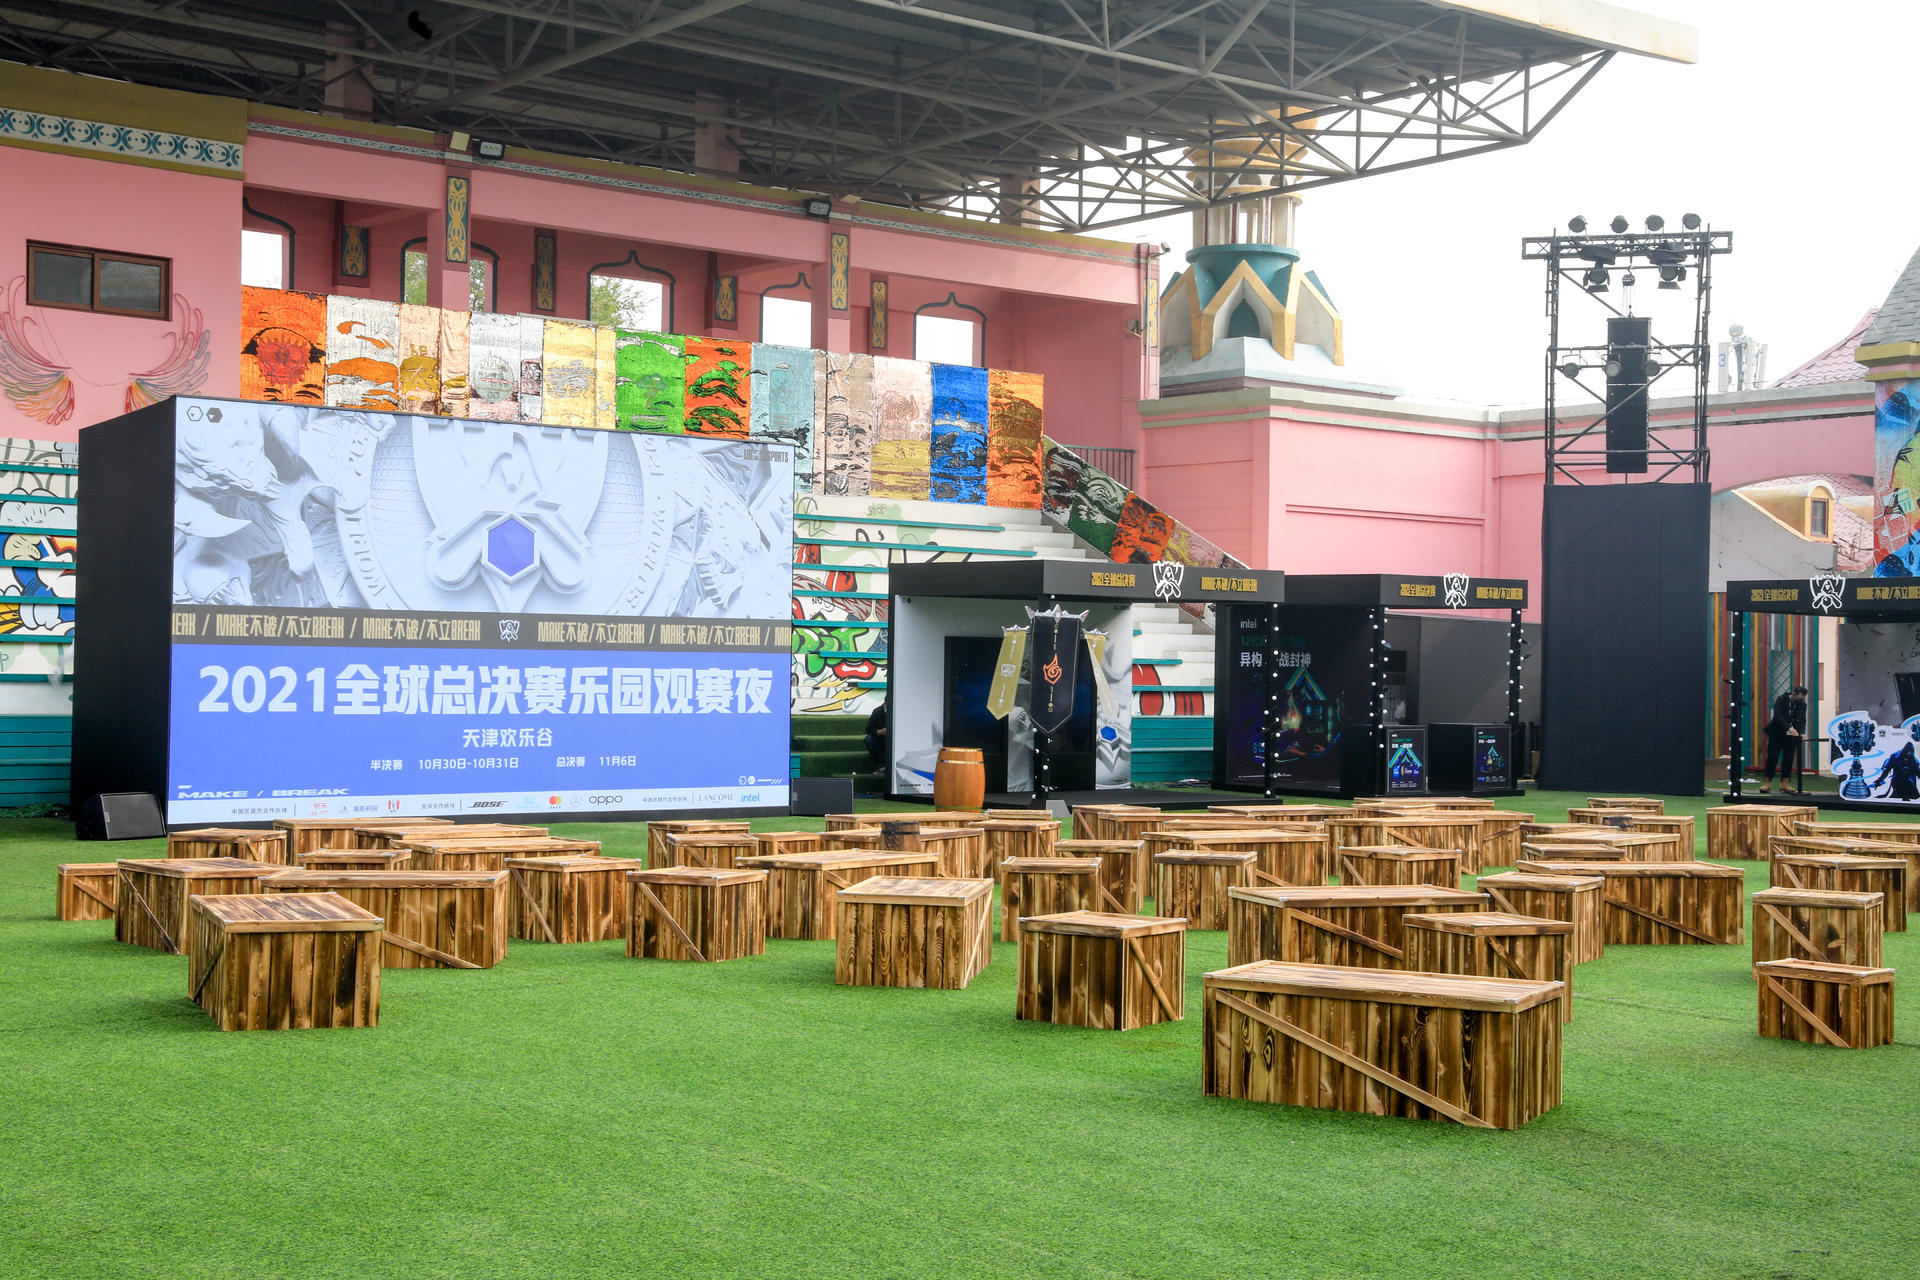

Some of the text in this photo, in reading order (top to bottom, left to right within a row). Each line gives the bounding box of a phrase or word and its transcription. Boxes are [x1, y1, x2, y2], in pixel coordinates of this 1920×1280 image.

[1278, 651, 1312, 668] 战封神
[198, 664, 773, 715] 2021全球总决赛乐园观赛夜
[463, 728, 553, 748] 天津欢乐谷
[370, 755, 637, 771] 半决赛 10月30日-10月31日 总决赛 11月6日
[178, 791, 248, 799] MAKE
[271, 788, 349, 797] BREAK
[741, 792, 760, 803] intel
